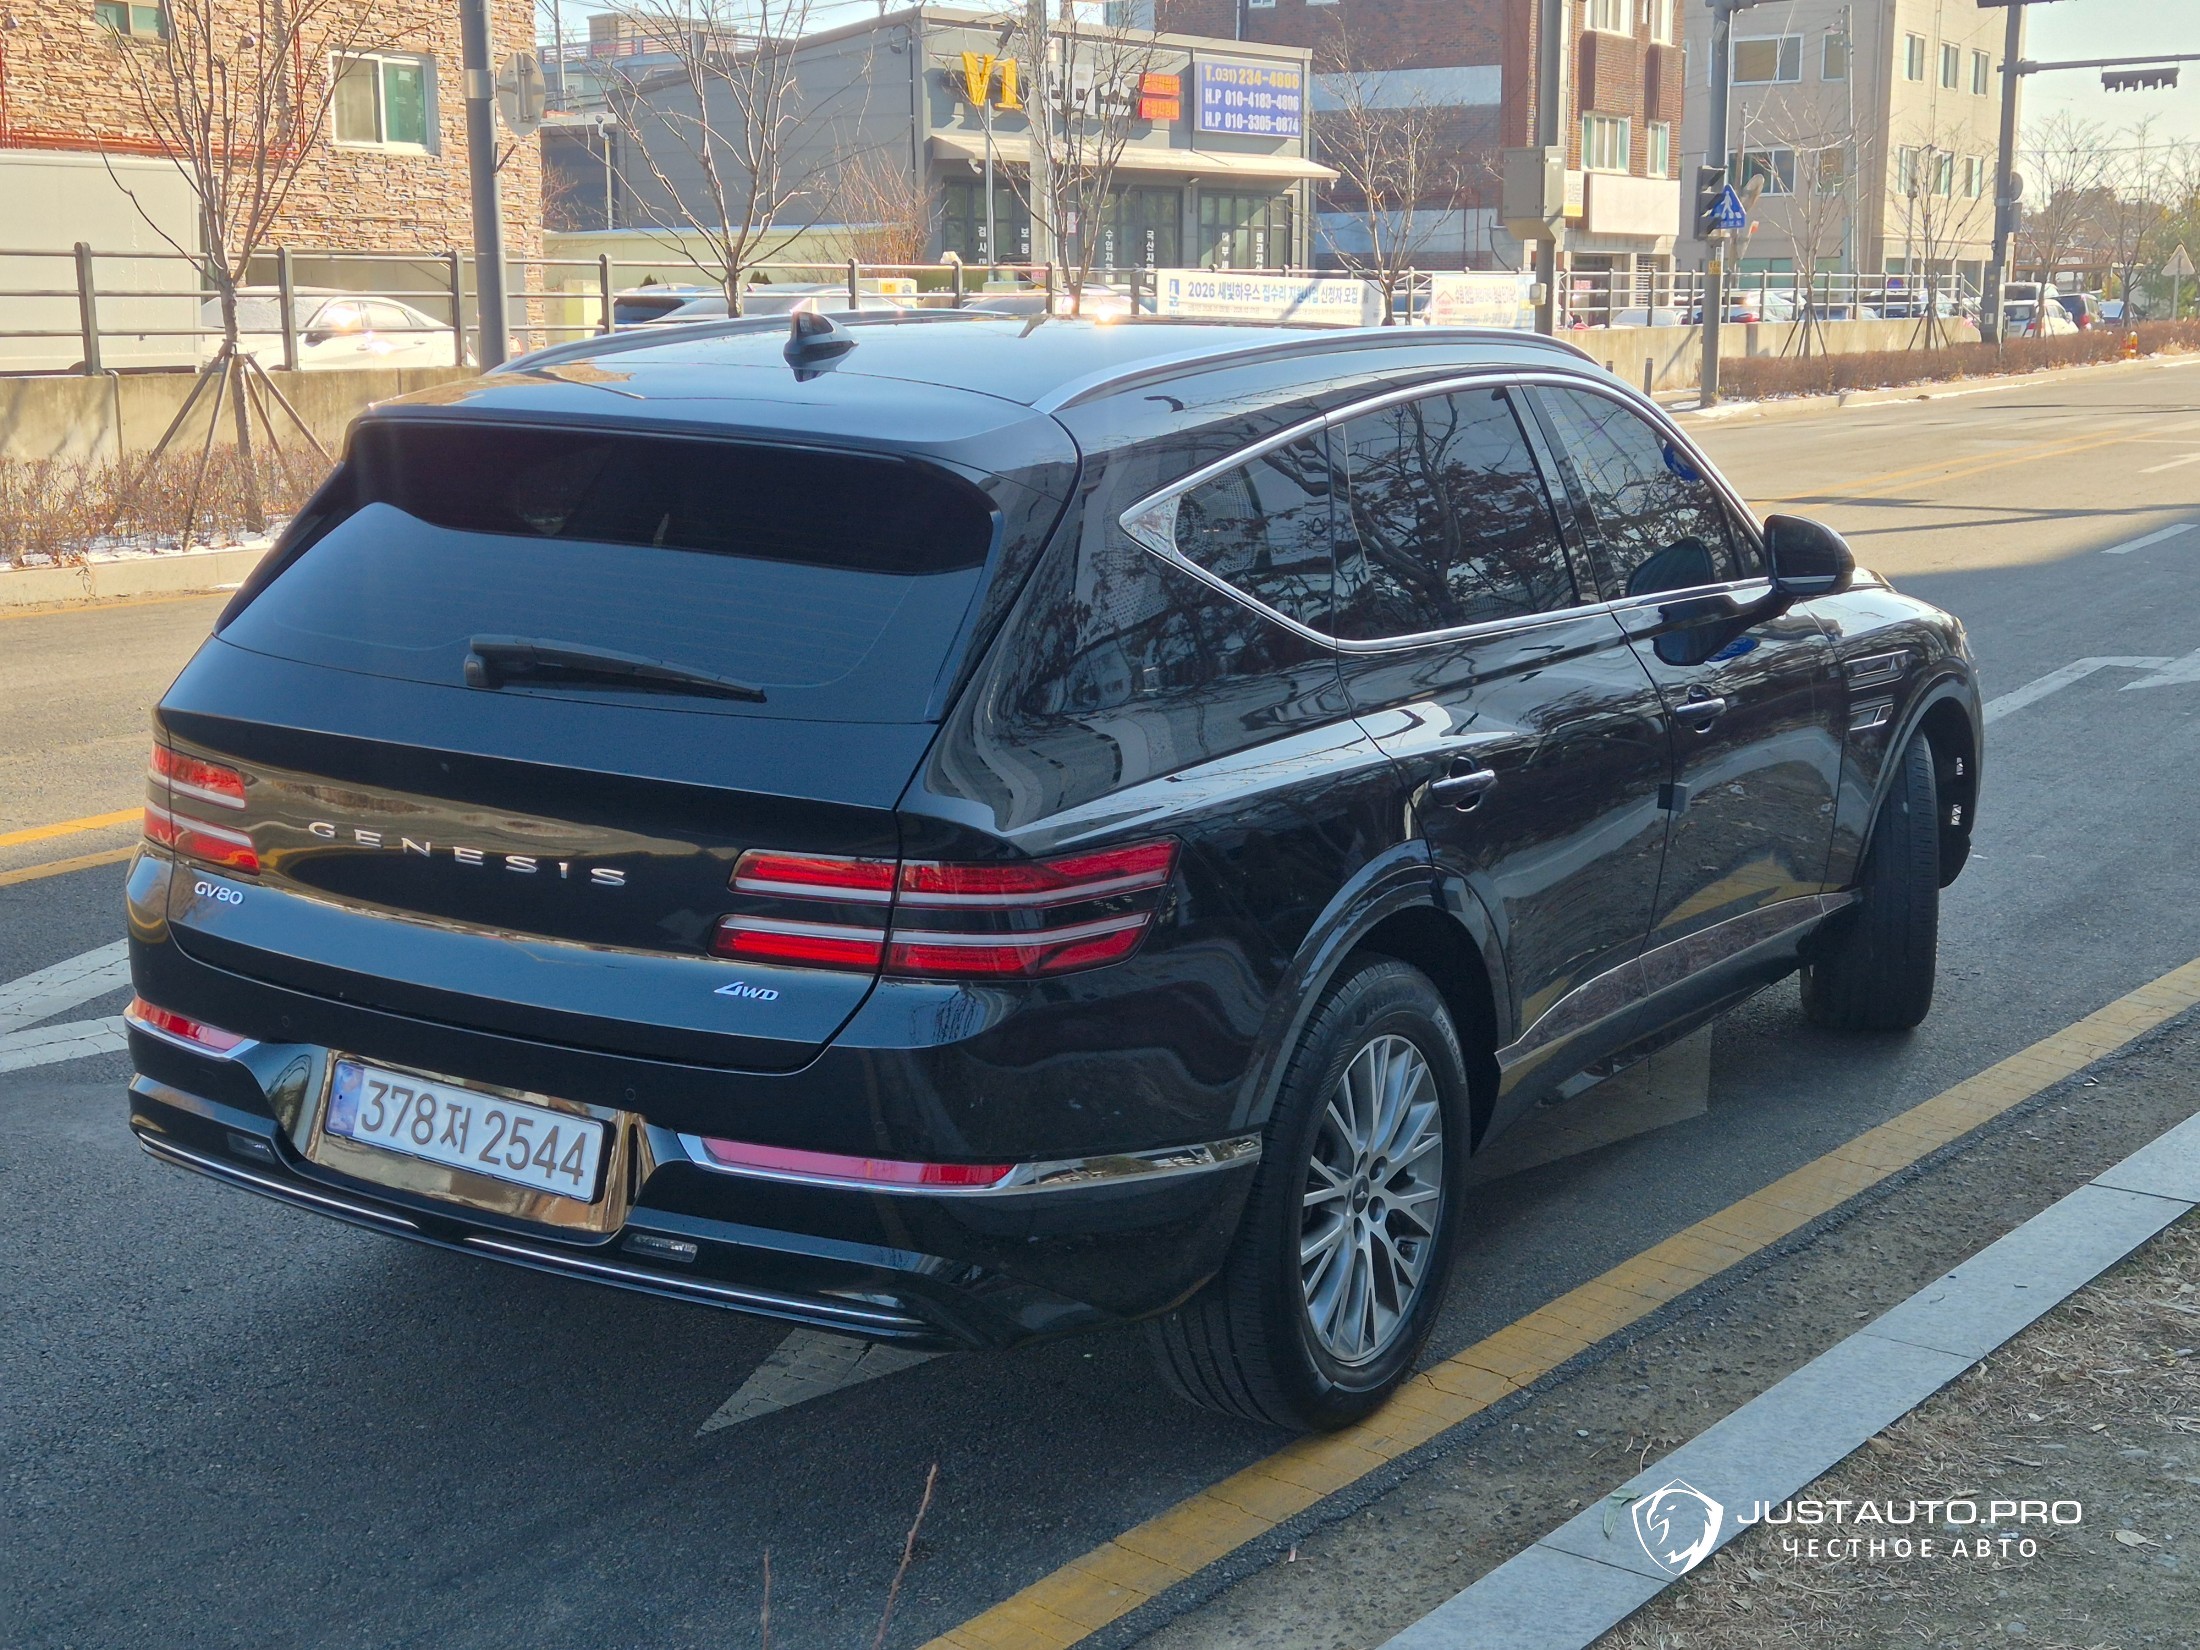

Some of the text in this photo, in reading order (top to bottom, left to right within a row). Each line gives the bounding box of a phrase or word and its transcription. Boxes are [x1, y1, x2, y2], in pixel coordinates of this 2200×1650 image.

[961, 51, 1024, 111] V1
[1238, 68, 1300, 90] 234-4806
[1204, 88, 1299, 112] H.P 010-4183-4806
[1204, 110, 1299, 133] H.P 010-3305-0874
[1187, 281, 1215, 298] 2026
[1217, 282, 1261, 302] 새빛하우스
[1262, 284, 1287, 304] 집수리
[1320, 285, 1342, 304] 신청자
[1343, 286, 1359, 304] 모집
[308, 821, 626, 888] GENESIS
[193, 880, 245, 906] GV80
[360, 1080, 588, 1186] 378저 2544
